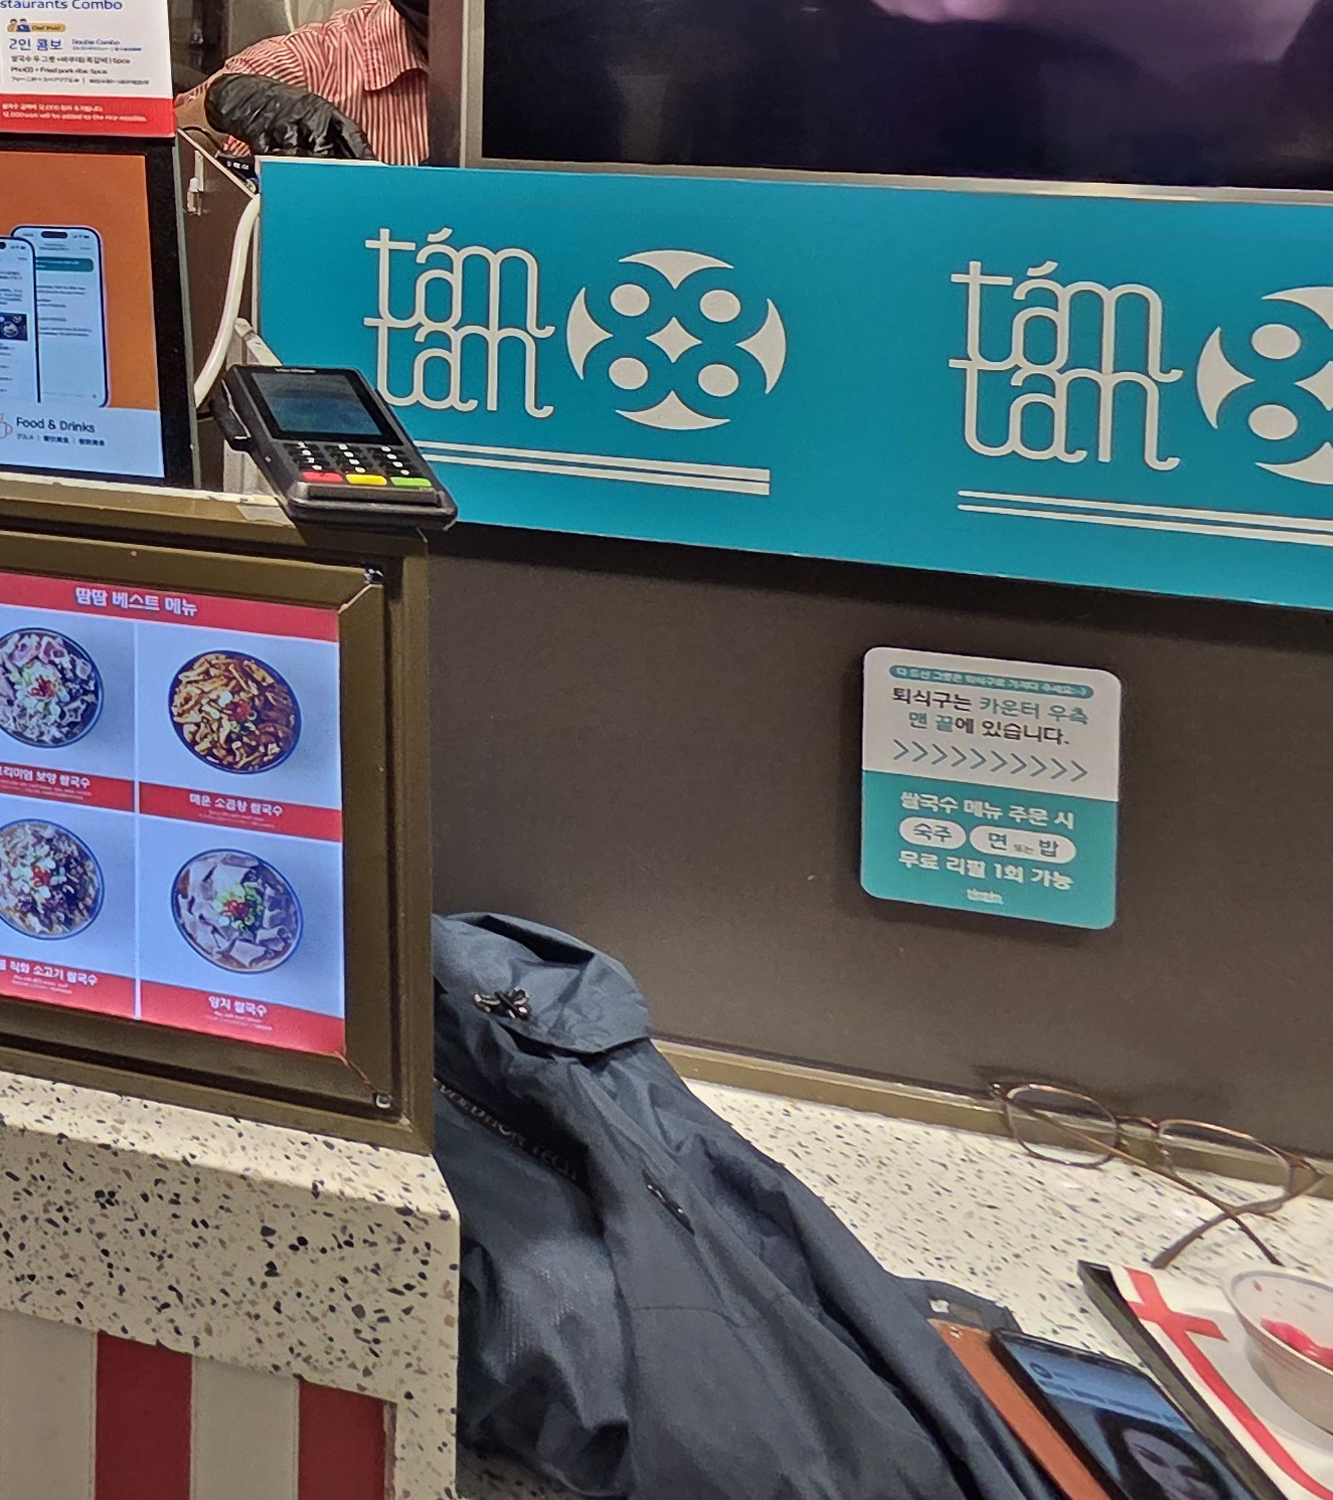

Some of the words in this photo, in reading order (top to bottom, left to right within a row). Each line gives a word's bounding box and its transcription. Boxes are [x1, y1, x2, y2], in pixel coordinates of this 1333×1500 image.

[72, 0, 123, 10] Combo
[9, 38, 31, 51] 2인
[37, 39, 63, 51] 콤보
[16, 417, 45, 429] Food
[48, 419, 56, 430] &
[59, 420, 95, 433] Drinks
[75, 587, 108, 607] 땀땀
[112, 591, 160, 612] 베스트
[164, 596, 198, 617] 메뉴
[891, 687, 972, 712] 퇴식구는
[979, 697, 1040, 720] 카운터
[1047, 705, 1089, 725] 우측
[909, 711, 928, 729] 맨
[936, 714, 974, 734] 끝에
[982, 720, 1070, 745] 있습니다.
[900, 791, 959, 815] 쌀국수
[963, 799, 1003, 820] 메뉴
[1007, 804, 1049, 825] 주문
[1053, 810, 1074, 830] 시
[913, 822, 952, 843] 숙주
[988, 832, 1008, 851] 면
[1038, 837, 1059, 858] 밥
[899, 850, 939, 870] 무료
[945, 856, 987, 879] 리필
[994, 862, 1024, 883] 1회
[1031, 868, 1074, 891] 가능
[33, 964, 65, 982] 소고기
[208, 995, 232, 1011] 양지
